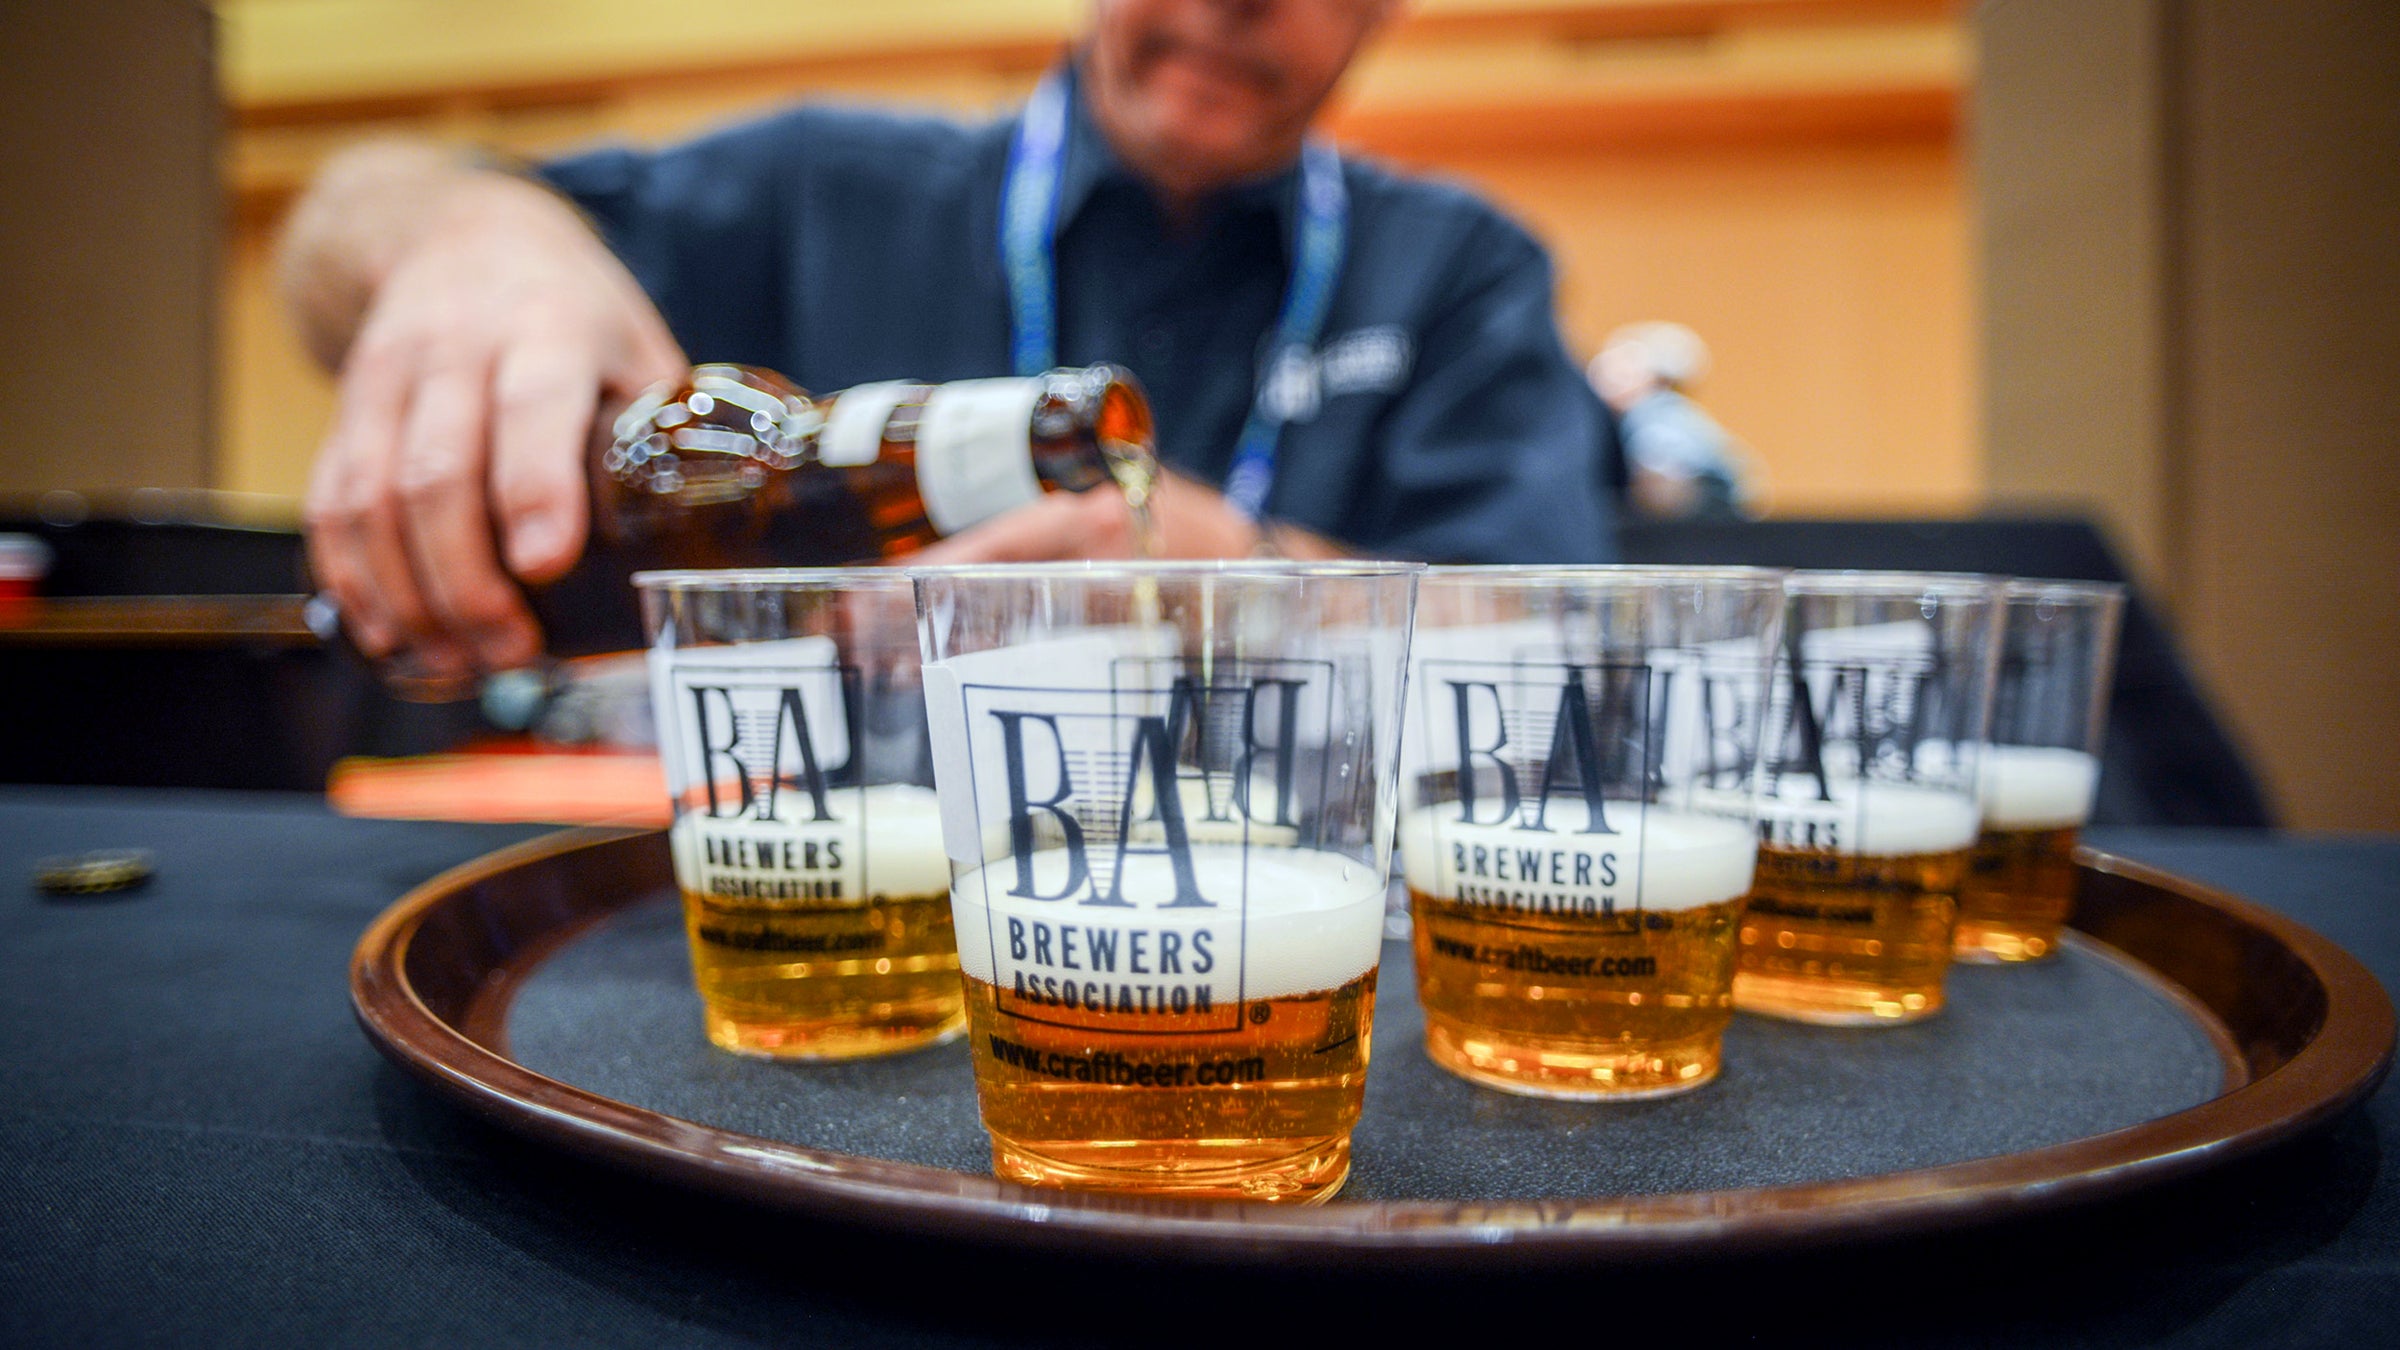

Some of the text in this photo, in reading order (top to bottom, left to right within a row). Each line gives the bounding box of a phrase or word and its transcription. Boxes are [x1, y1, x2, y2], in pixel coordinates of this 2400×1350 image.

[691, 687, 841, 821] BA
[1445, 680, 1621, 834] BA
[988, 709, 1217, 908] BA
[1453, 842, 1617, 886] BREWERS
[1008, 916, 1214, 974] BREWERS
[1014, 969, 1213, 1014] ASSOCIATION
[989, 1033, 1265, 1086] www.craftbeer.com
